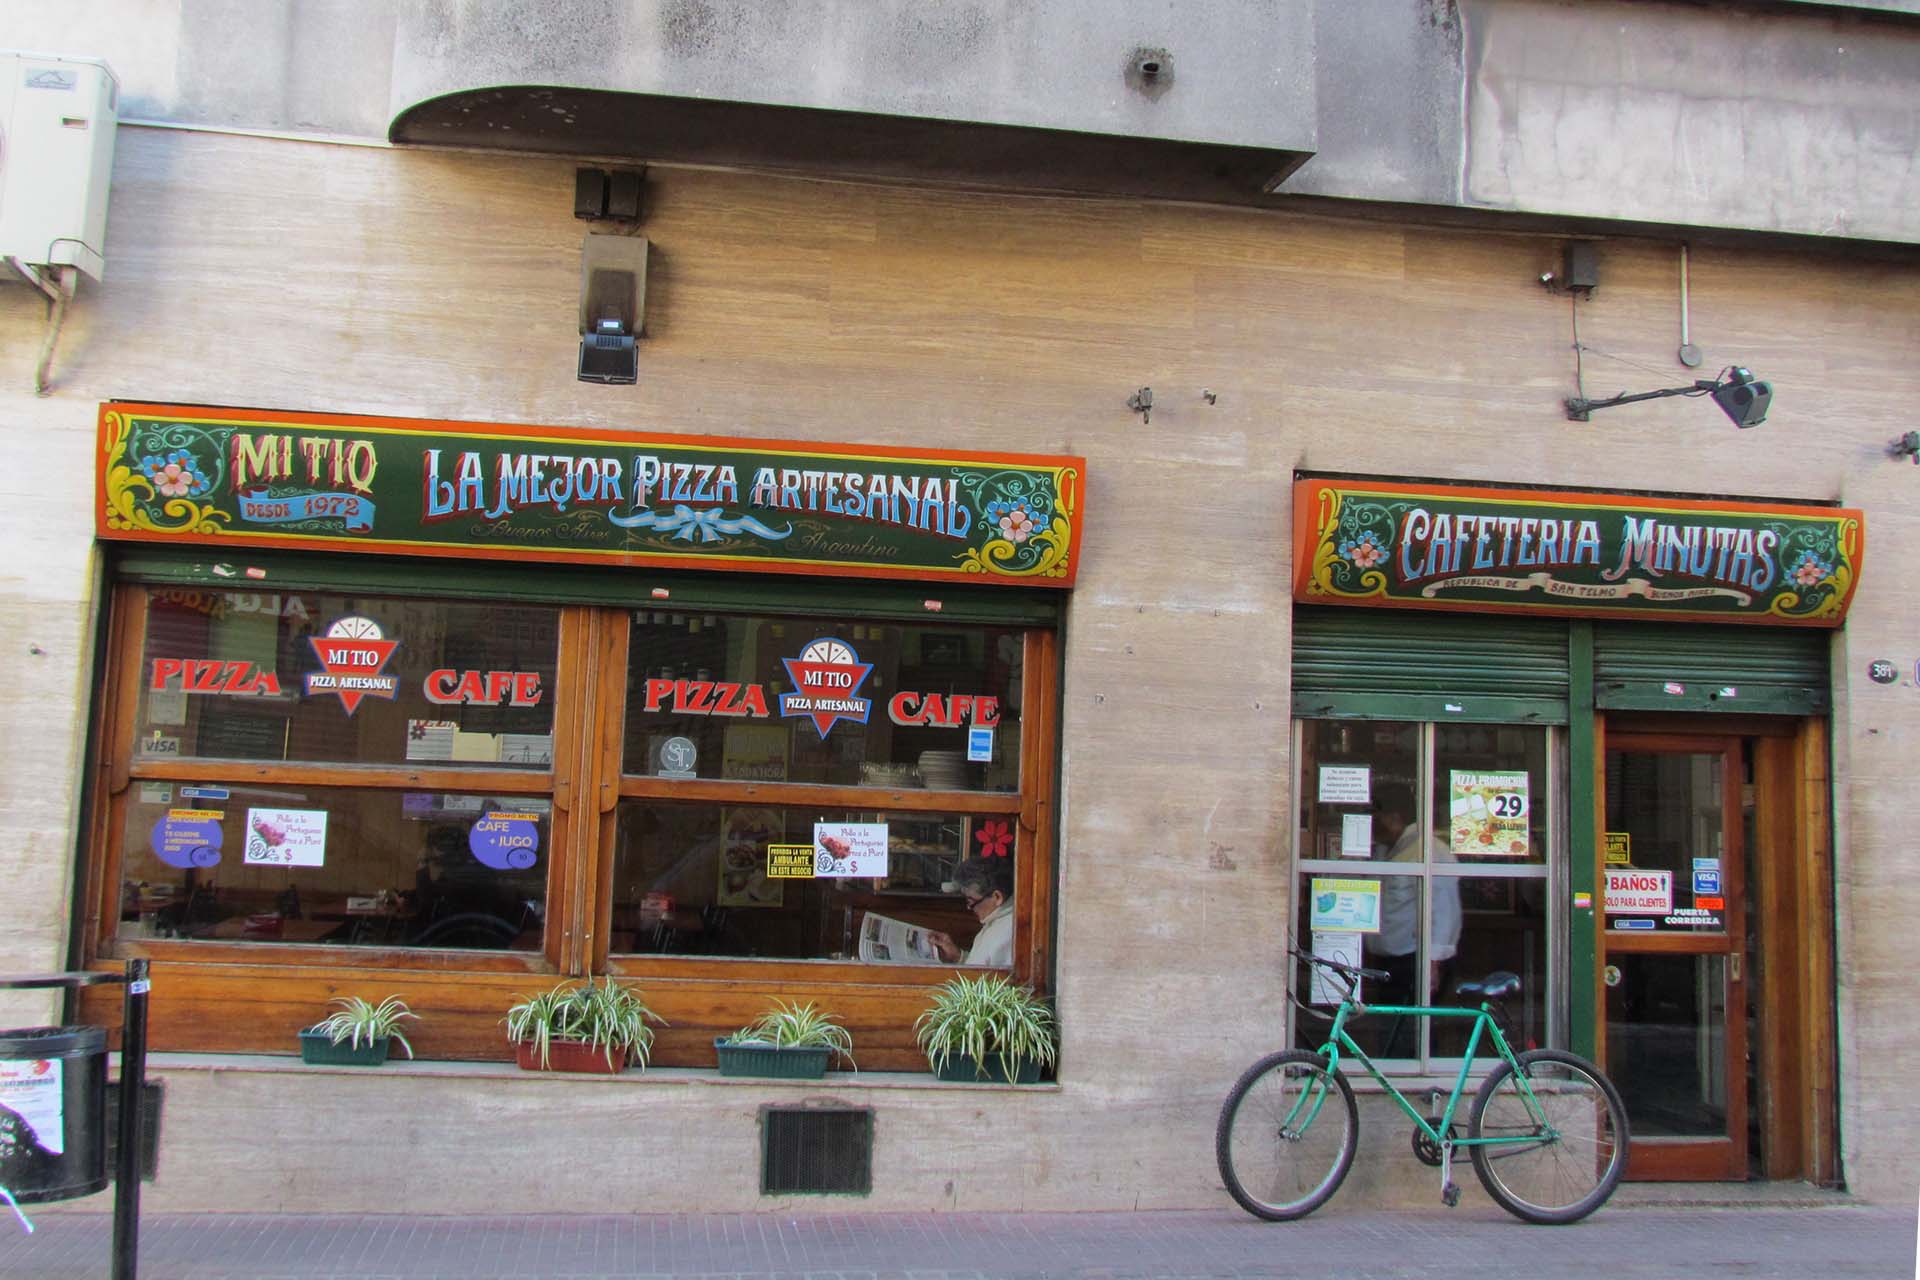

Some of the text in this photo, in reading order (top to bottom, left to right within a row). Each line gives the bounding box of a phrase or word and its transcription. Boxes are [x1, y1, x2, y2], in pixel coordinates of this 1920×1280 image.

[233, 433, 378, 494] MI TIO
[421, 448, 973, 541] LA MEJOR PIZZA ARTESANAL
[245, 496, 360, 518] DESDE 1972
[1400, 508, 1778, 593] CAFETERIA MINUTAS
[1443, 578, 1500, 588] REPUBLICA
[1506, 580, 1518, 589] DE
[1580, 585, 1617, 597] TELMO
[328, 649, 379, 667] MI TIO
[151, 658, 282, 696] PIZZA
[1873, 663, 1892, 678] 389
[310, 675, 393, 690] PIZZA ARTESANAL
[804, 670, 852, 688] MI TIO
[423, 669, 543, 707] CAFE
[643, 678, 770, 718] PIZZA
[786, 697, 865, 712] PIZZA ARTESANAL
[888, 692, 1000, 729] CAFE
[146, 741, 177, 752] VISA
[1495, 795, 1523, 817] 29
[476, 821, 510, 832] CAFE
[498, 836, 532, 847] JUGO
[284, 848, 292, 861] $
[774, 855, 809, 865] AMBULANTE
[771, 866, 812, 875] EN ESTE NEGOCIO
[850, 861, 858, 873] $
[1610, 874, 1658, 891] BAÑOS
[1697, 873, 1716, 881] VISA
[1620, 898, 1637, 907] PARA
[1638, 898, 1666, 908] CLIENTES
[1664, 917, 1720, 925] CORREDIZA
